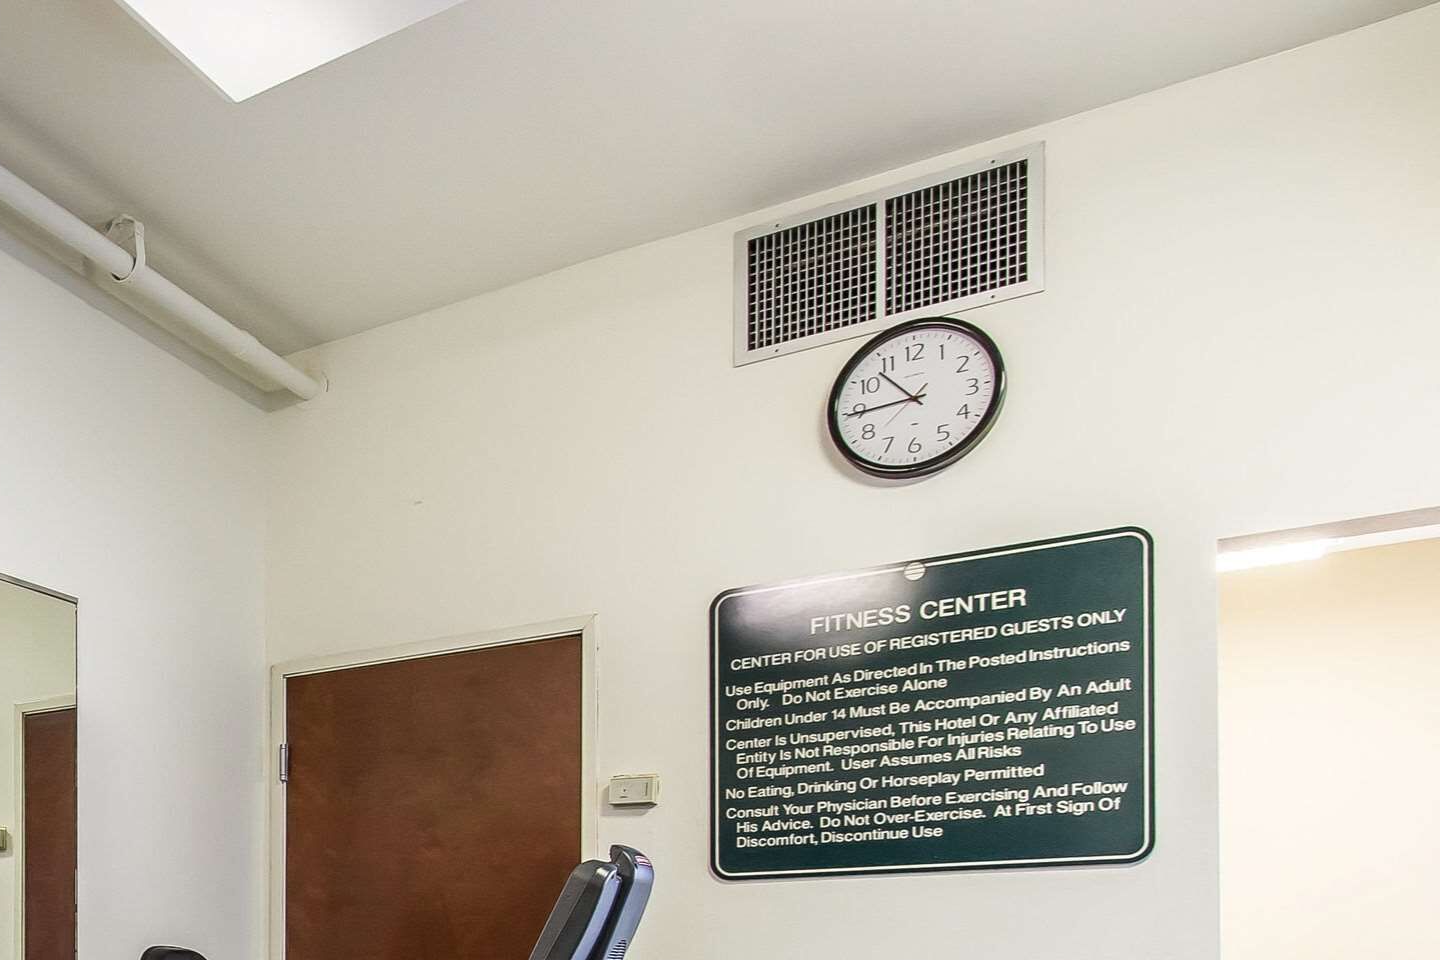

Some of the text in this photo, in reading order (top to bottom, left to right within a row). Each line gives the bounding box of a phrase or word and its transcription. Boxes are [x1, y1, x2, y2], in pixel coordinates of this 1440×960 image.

[905, 344, 924, 361] 12
[882, 356, 895, 373] 11
[955, 355, 970, 373] 2
[860, 377, 881, 395] 10
[965, 378, 979, 395] 3
[852, 403, 867, 419] 9
[956, 404, 970, 420] 4
[861, 423, 876, 440] 8
[937, 424, 950, 441] 5
[882, 436, 895, 453] 7
[908, 437, 922, 453] 6
[811, 588, 1027, 634] FITNESS CENTER
[730, 608, 1127, 671] CENTER FOR USE OF REGISTERED GUESTS ONLY
[725, 640, 1131, 697] Use Equipment As Directed In The Posted Instructions
[725, 678, 1132, 731] Children Under 14 Must Be Accompanied By An Adult
[736, 678, 948, 710] Only. Do Not Exercise Alone
[725, 701, 1119, 751] Center Is Unsupervised, This Hotel Or Any Affiliated
[736, 718, 1136, 765] Entity Is Not Responsible For Injuries Relating To Use
[736, 745, 1022, 779] Of Equipment. User Assumes All Risks
[725, 763, 1045, 800] No Eating, Drinking Or Horseplay Permitted
[725, 781, 1128, 819] Consult Your Physician Before Exercising And Follow
[736, 796, 1121, 833] His Advice. Do Not Over-Exercise. At First Sign Of
[736, 826, 943, 848] Discomfort, Discontinue Use
